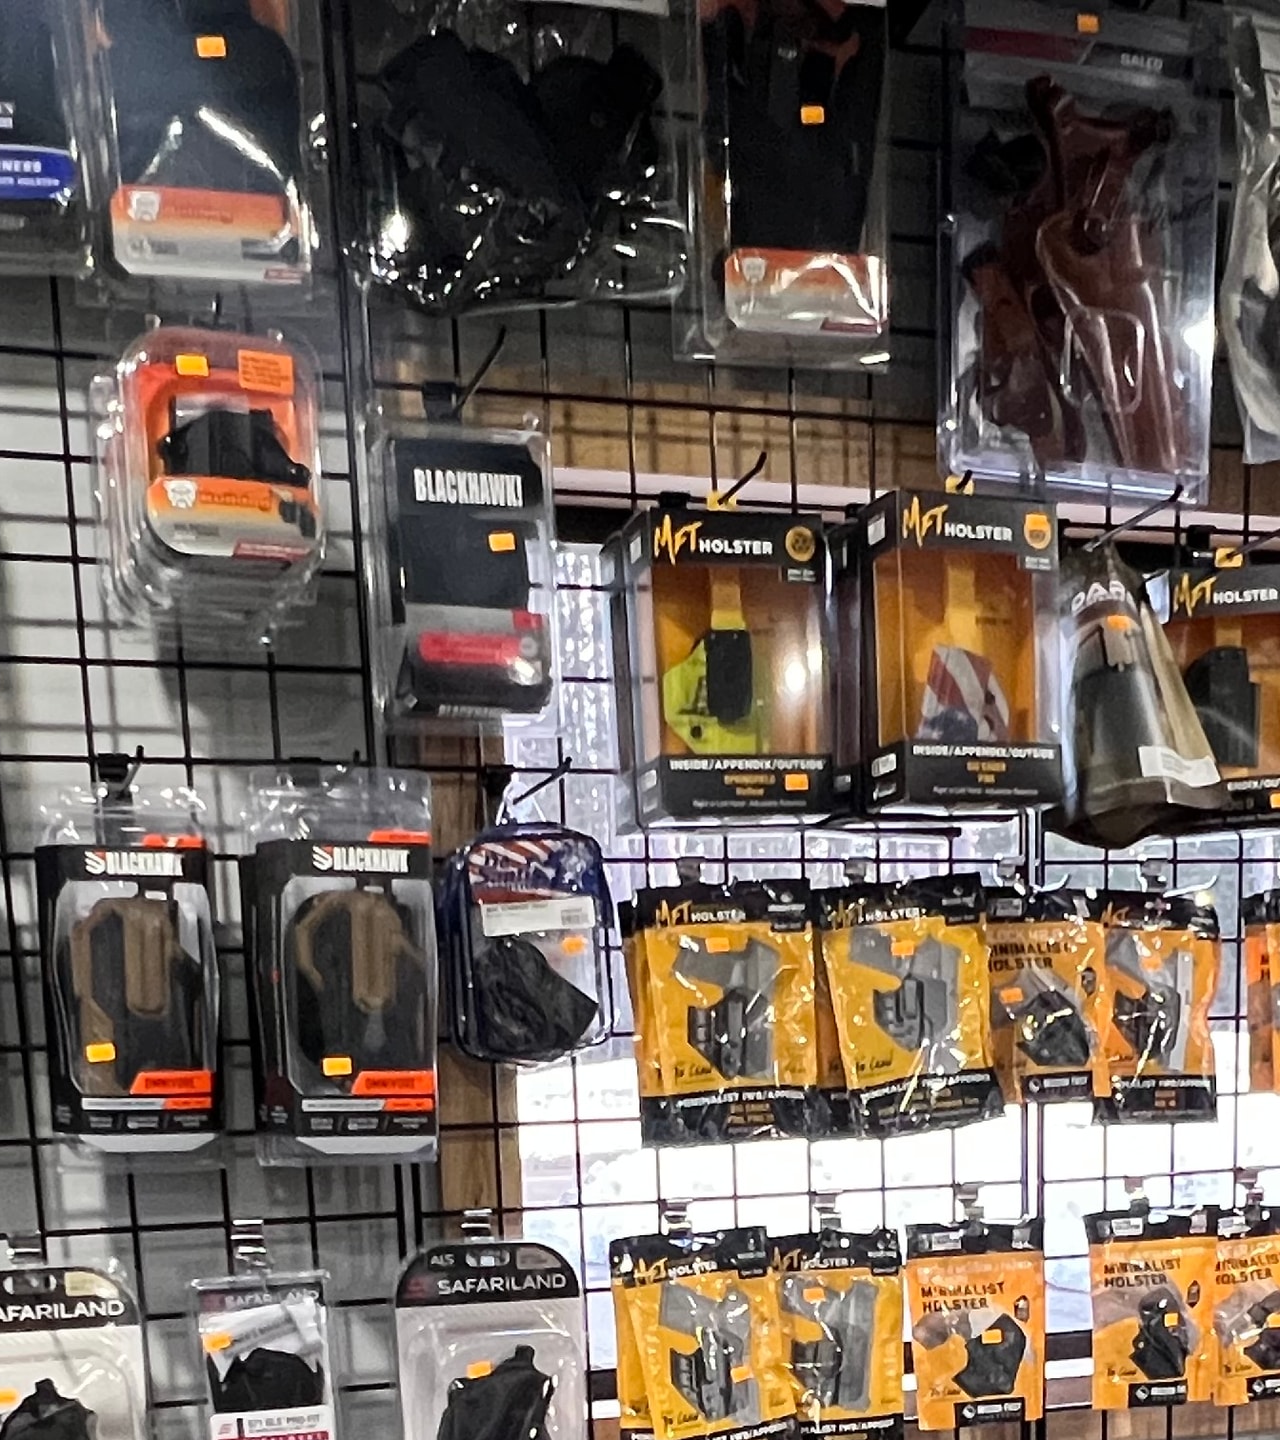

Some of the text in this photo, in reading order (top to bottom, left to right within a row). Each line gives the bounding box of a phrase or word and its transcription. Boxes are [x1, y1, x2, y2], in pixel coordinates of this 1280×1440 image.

[413, 468, 524, 507] BLACKHAWK!
[944, 522, 1013, 541] HOLSTER
[699, 539, 773, 555] HOLSTER
[1212, 588, 1279, 605] HOLSTER
[430, 1254, 456, 1267] ALS
[436, 1272, 567, 1296] SAFARILAND
[1104, 1274, 1168, 1288] HOLSTER
[922, 1298, 988, 1314] HOLSTER
